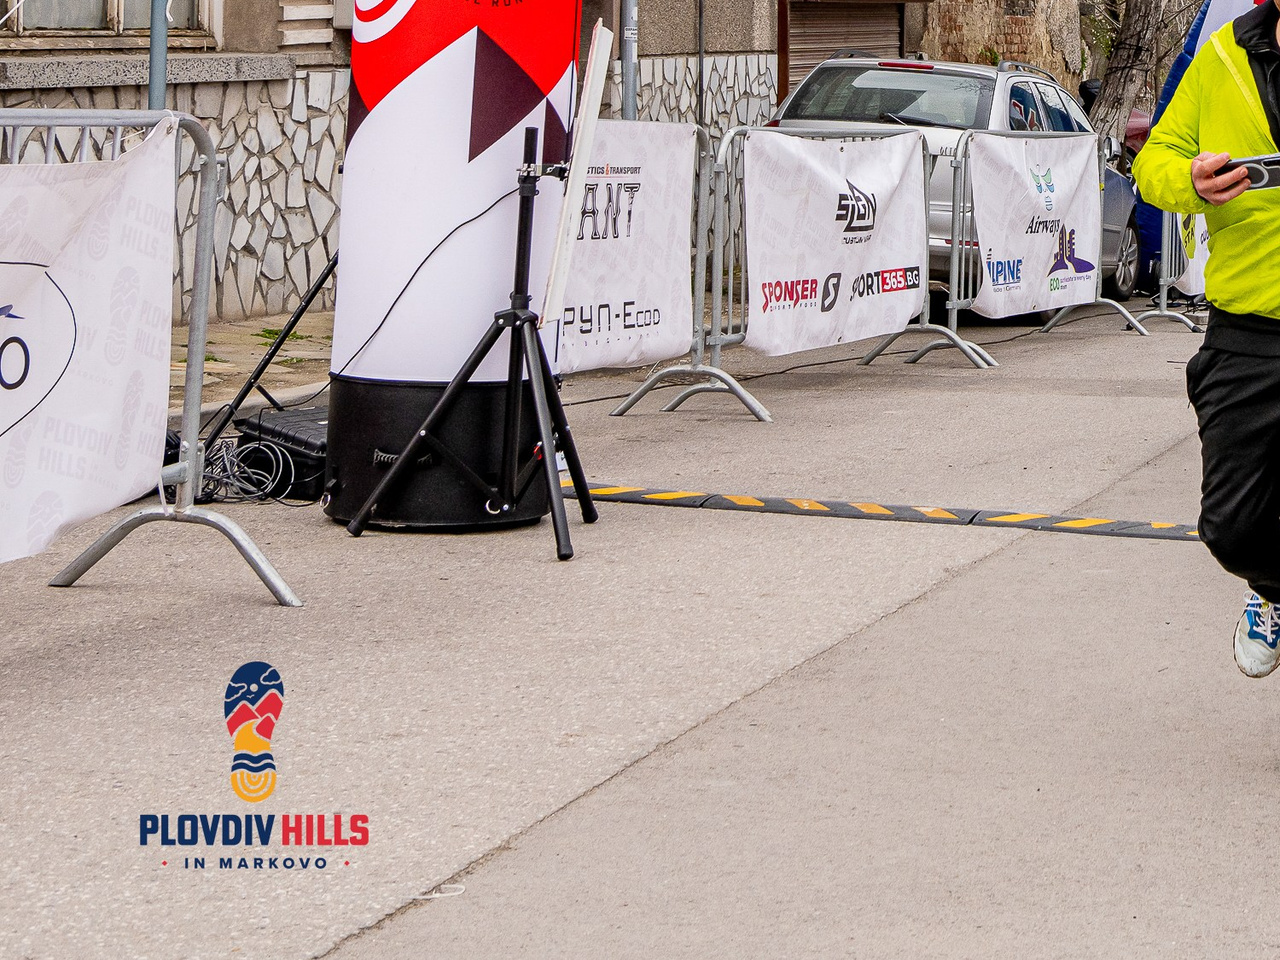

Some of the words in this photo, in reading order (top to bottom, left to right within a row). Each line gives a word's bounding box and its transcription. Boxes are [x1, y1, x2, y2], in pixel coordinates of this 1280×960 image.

[609, 166, 641, 175] TRANSPORT
[1025, 216, 1060, 237] Airways
[1049, 277, 1060, 292] ECO
[761, 278, 818, 313] SPONSER
